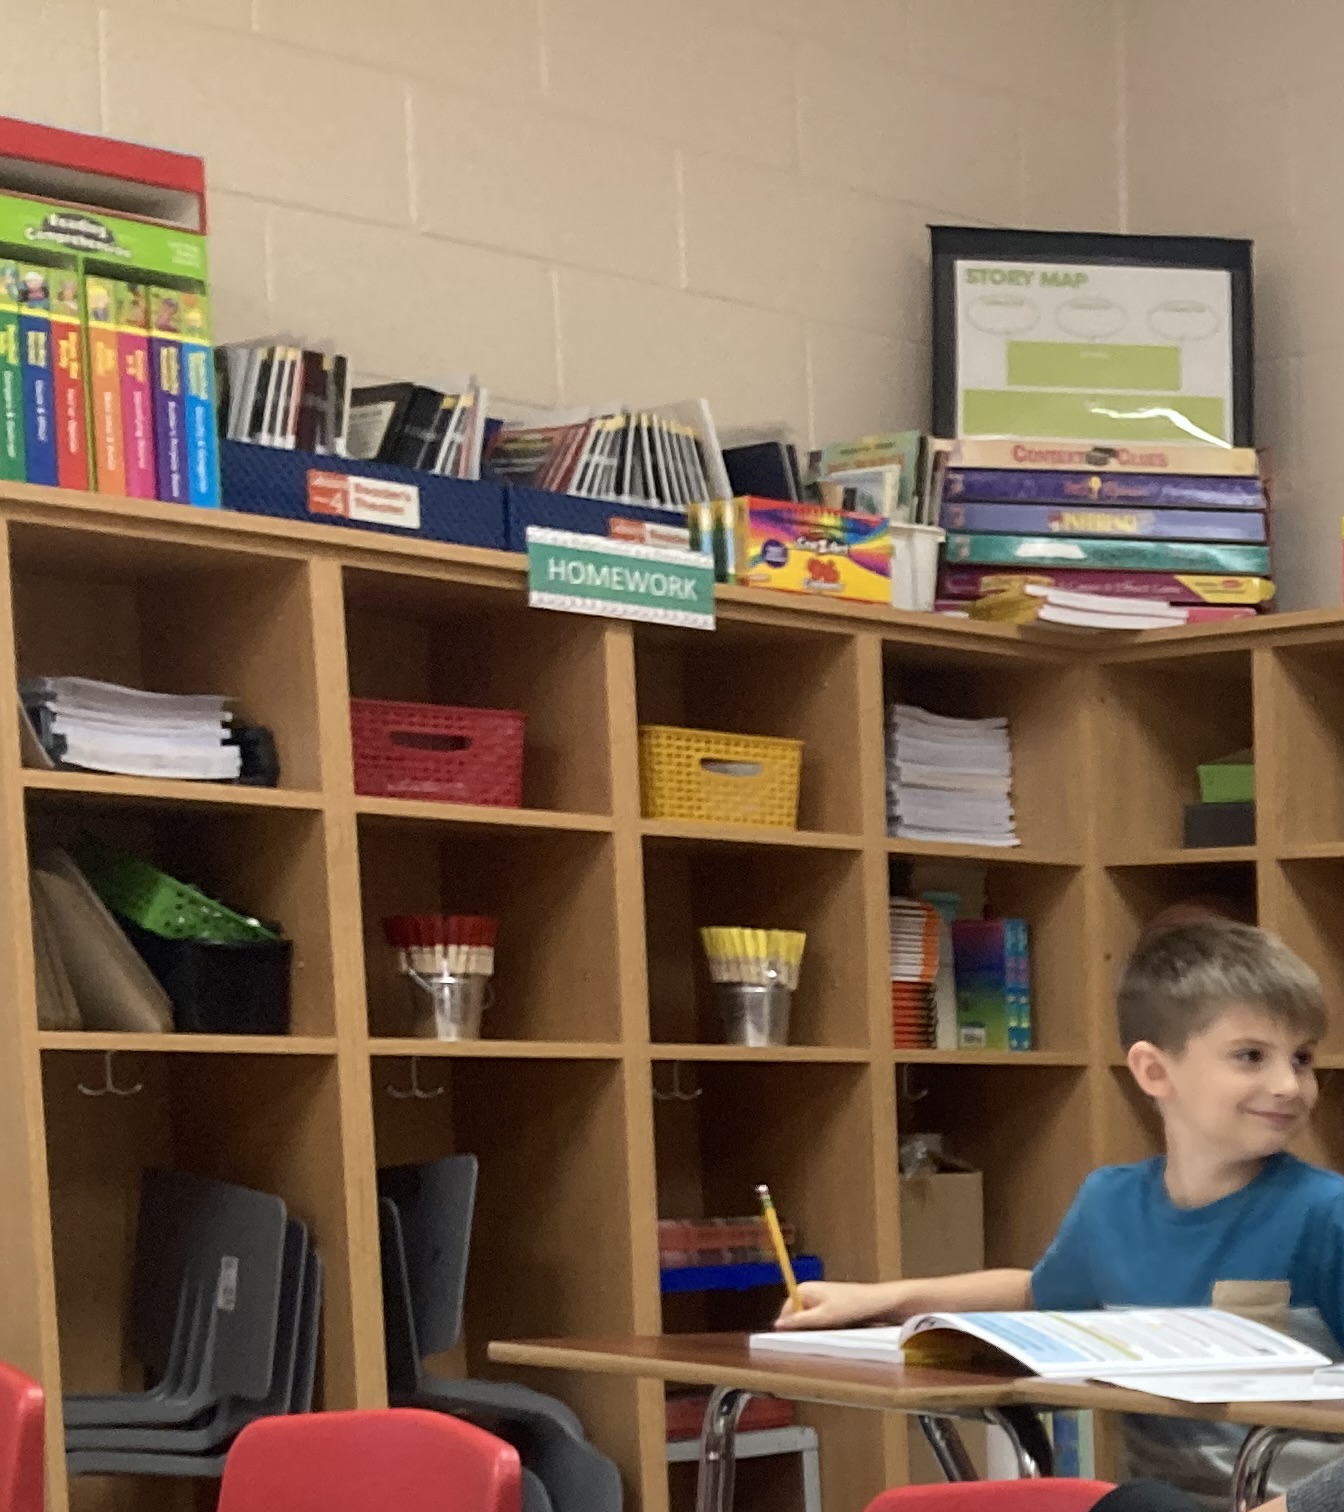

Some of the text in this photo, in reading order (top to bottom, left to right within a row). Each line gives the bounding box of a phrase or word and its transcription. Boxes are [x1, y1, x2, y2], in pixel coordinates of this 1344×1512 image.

[965, 267, 1089, 289] STORY MAP
[546, 556, 699, 600] HOMEWORK
